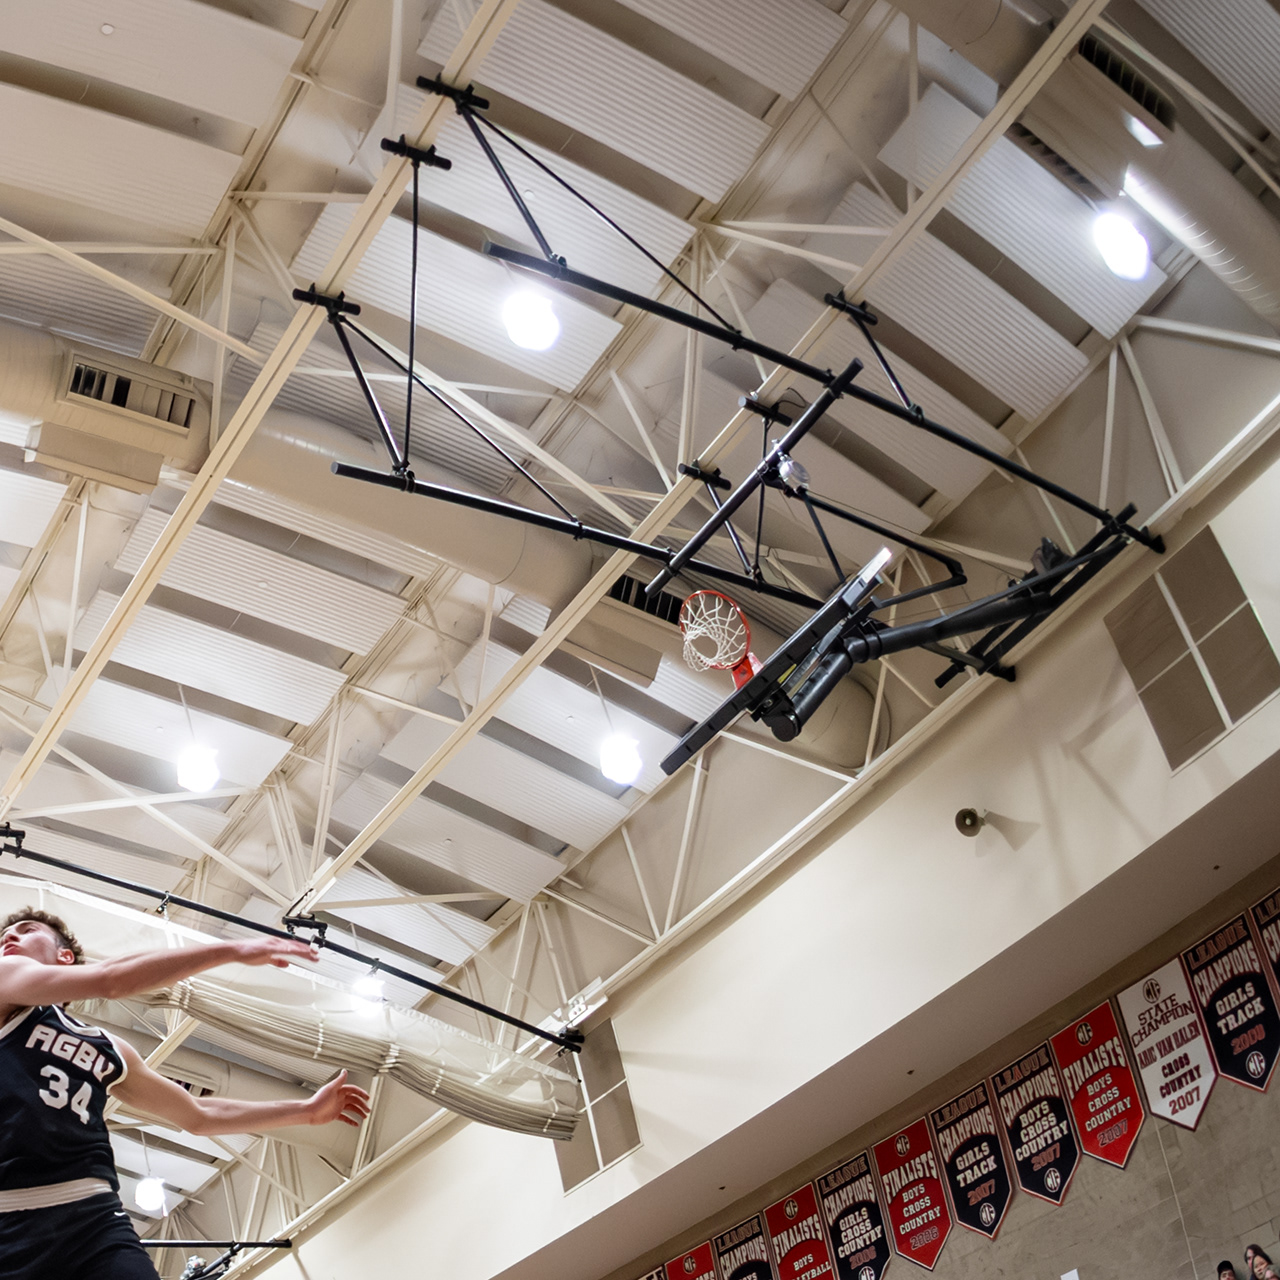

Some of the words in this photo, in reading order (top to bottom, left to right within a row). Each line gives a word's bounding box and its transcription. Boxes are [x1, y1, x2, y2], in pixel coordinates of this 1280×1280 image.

[1193, 939, 1261, 1008] CHAMPIONS
[1138, 993, 1179, 1026] STATE
[1215, 981, 1255, 1016] GIRLS
[1132, 1000, 1195, 1048] CHAMPION
[1217, 997, 1265, 1035] TRACK
[24, 1024, 116, 1082] AGBU
[1156, 1035, 1173, 1058] VAN
[1175, 1020, 1200, 1049] HALEN
[994, 1047, 1049, 1093] LEAGUE
[1063, 1037, 1126, 1100] FINALISTS
[1160, 1064, 1202, 1098] COUNTRY
[1162, 1053, 1190, 1078] CROSS
[39, 1065, 90, 1125] 34
[1000, 1067, 1059, 1126] CHAMPIONS
[1087, 1073, 1112, 1096] BOYS
[1088, 1087, 1119, 1112] CROSS
[1169, 1086, 1200, 1115] 2007
[1019, 1101, 1050, 1128] BOYS
[1020, 1113, 1057, 1142] CROSS
[1085, 1097, 1131, 1132] COUNTRY
[938, 1105, 995, 1163] CHAMPIONS
[1015, 1120, 1068, 1161] COUNTRY
[956, 1142, 989, 1170] GIRLS
[956, 1156, 997, 1187] TRACK
[882, 1151, 937, 1204] FINALISTS
[902, 1183, 925, 1202] BOYS
[824, 1174, 875, 1226] CHAMPIONS
[903, 1196, 931, 1218] CROSS
[839, 1207, 868, 1230] GIRLS
[841, 1219, 871, 1244] CROSS
[900, 1206, 940, 1235] COUNTRY
[772, 1213, 822, 1264] FINALISTS
[838, 1225, 882, 1258] COUNTRY
[794, 1254, 813, 1271] BOYS
